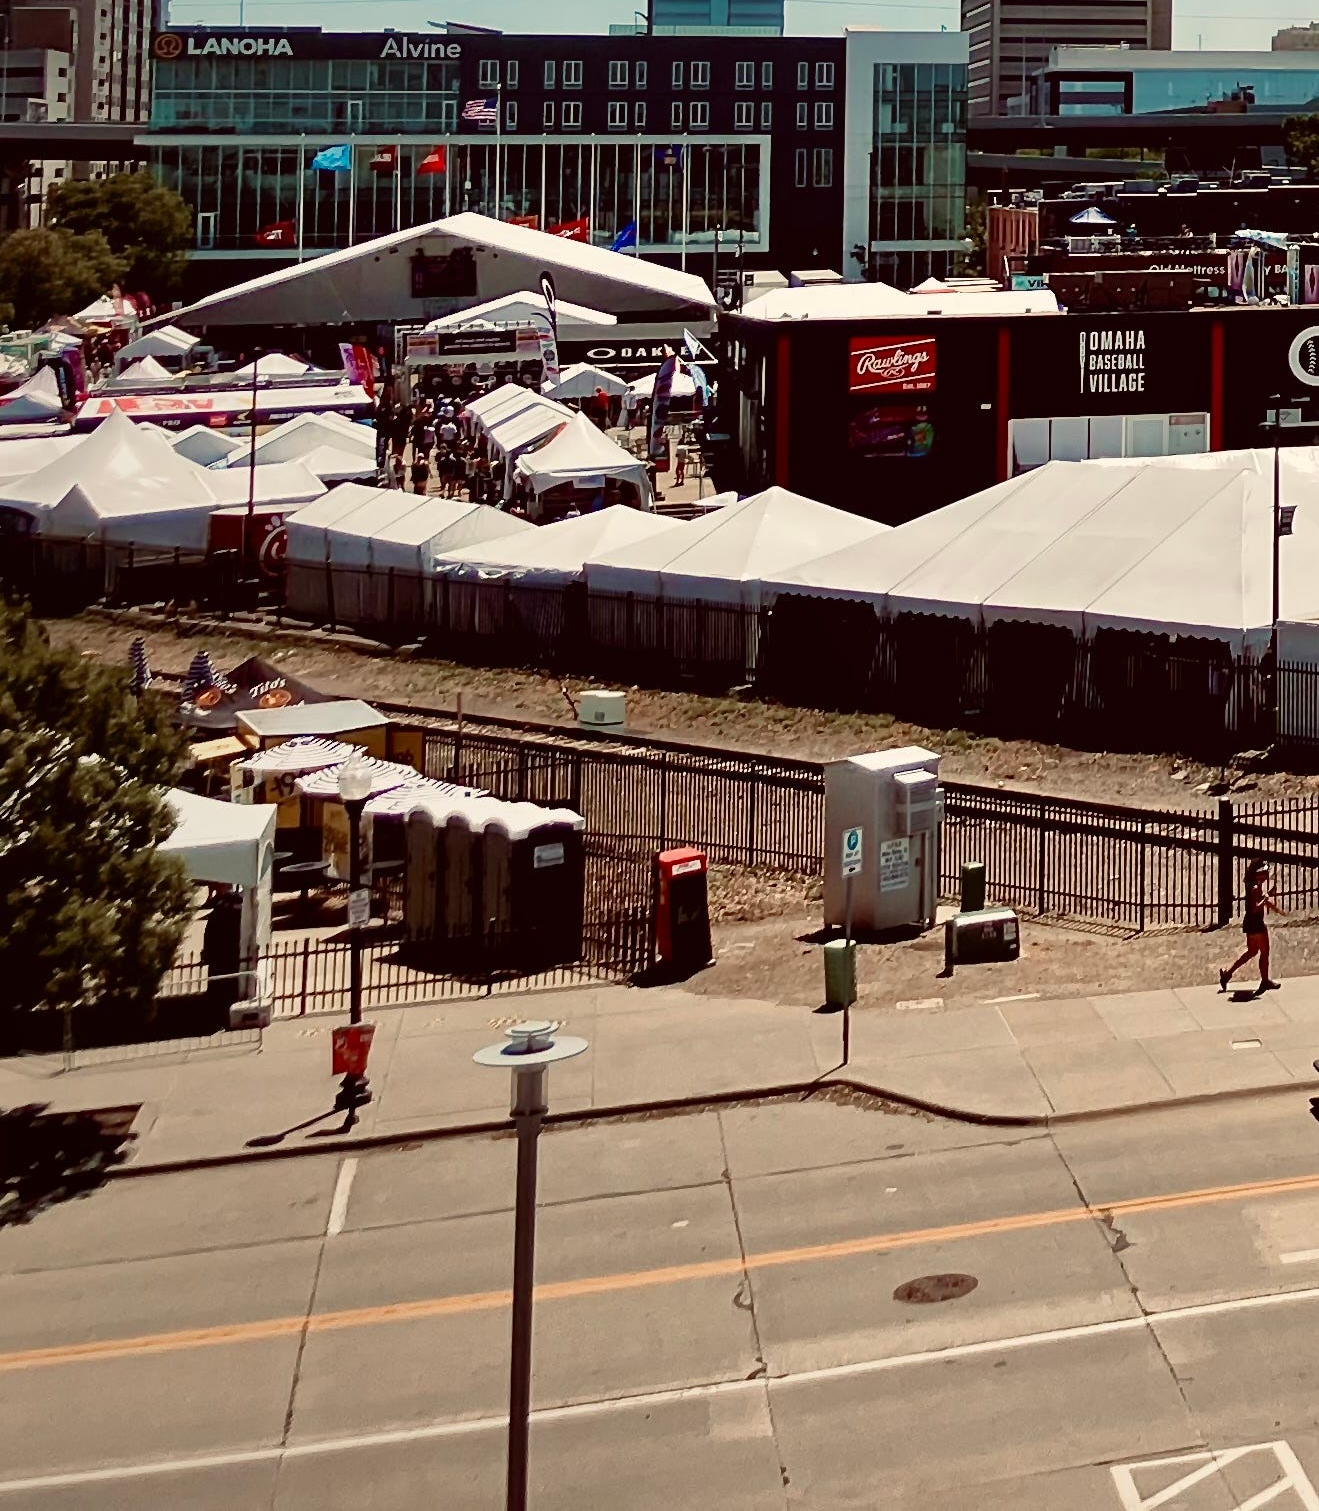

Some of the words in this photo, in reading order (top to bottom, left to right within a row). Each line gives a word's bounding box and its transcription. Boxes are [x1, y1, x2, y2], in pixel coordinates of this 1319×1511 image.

[187, 37, 294, 56] LANOHA
[379, 36, 462, 59] Alvine
[1089, 330, 1146, 350] OMAHA
[621, 345, 701, 358] OAKE
[856, 349, 930, 375] Rawlings
[1088, 353, 1145, 371] BASEBALL
[1088, 372, 1146, 393] VILLAGE
